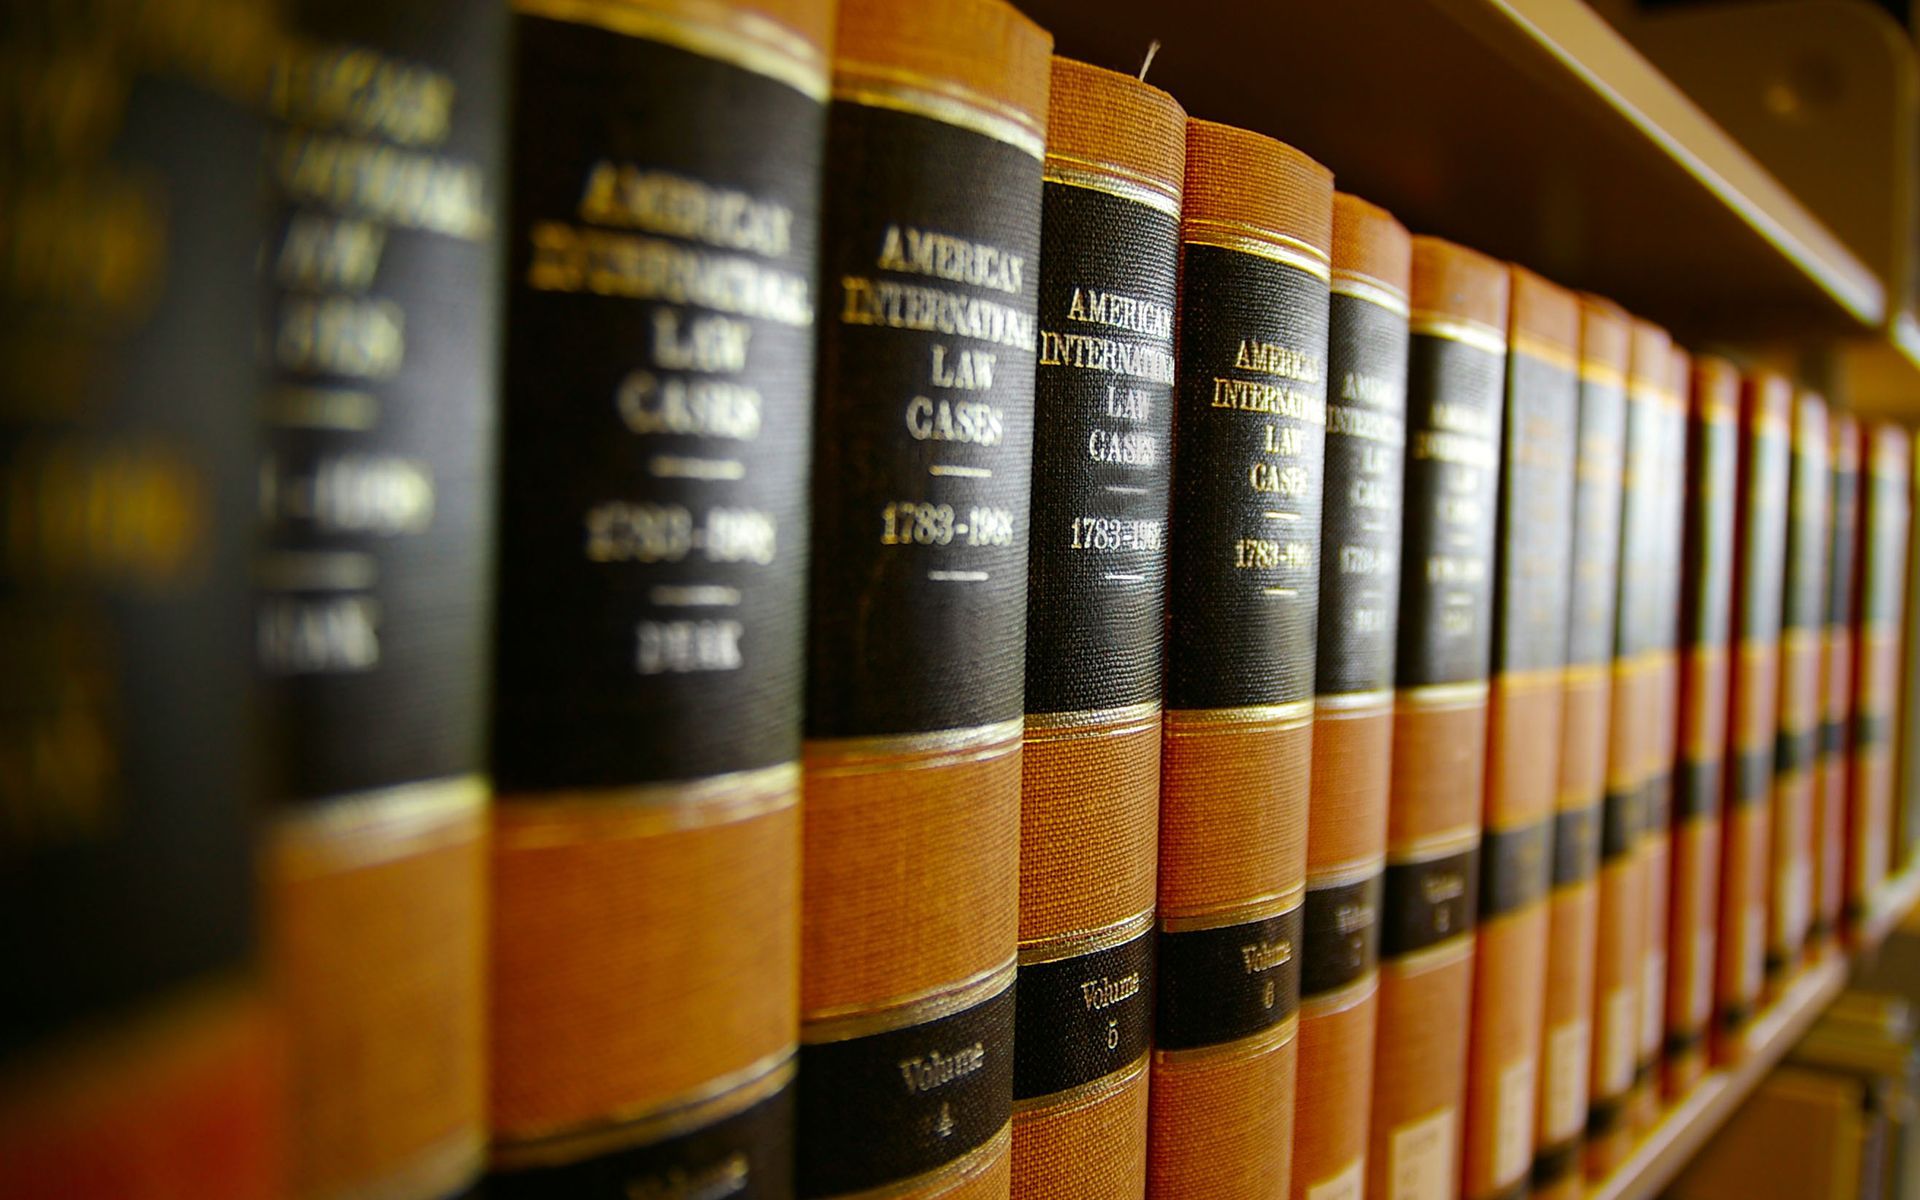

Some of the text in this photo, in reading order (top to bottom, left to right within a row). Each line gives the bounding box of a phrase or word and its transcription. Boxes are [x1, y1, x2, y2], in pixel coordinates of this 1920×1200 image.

[878, 226, 1024, 294] AMERICAN
[931, 344, 998, 390] LAW
[906, 395, 1004, 447] CASES
[1079, 972, 1141, 1012] Volume
[1106, 1018, 1120, 1050] 5
[899, 1041, 985, 1095] Volume
